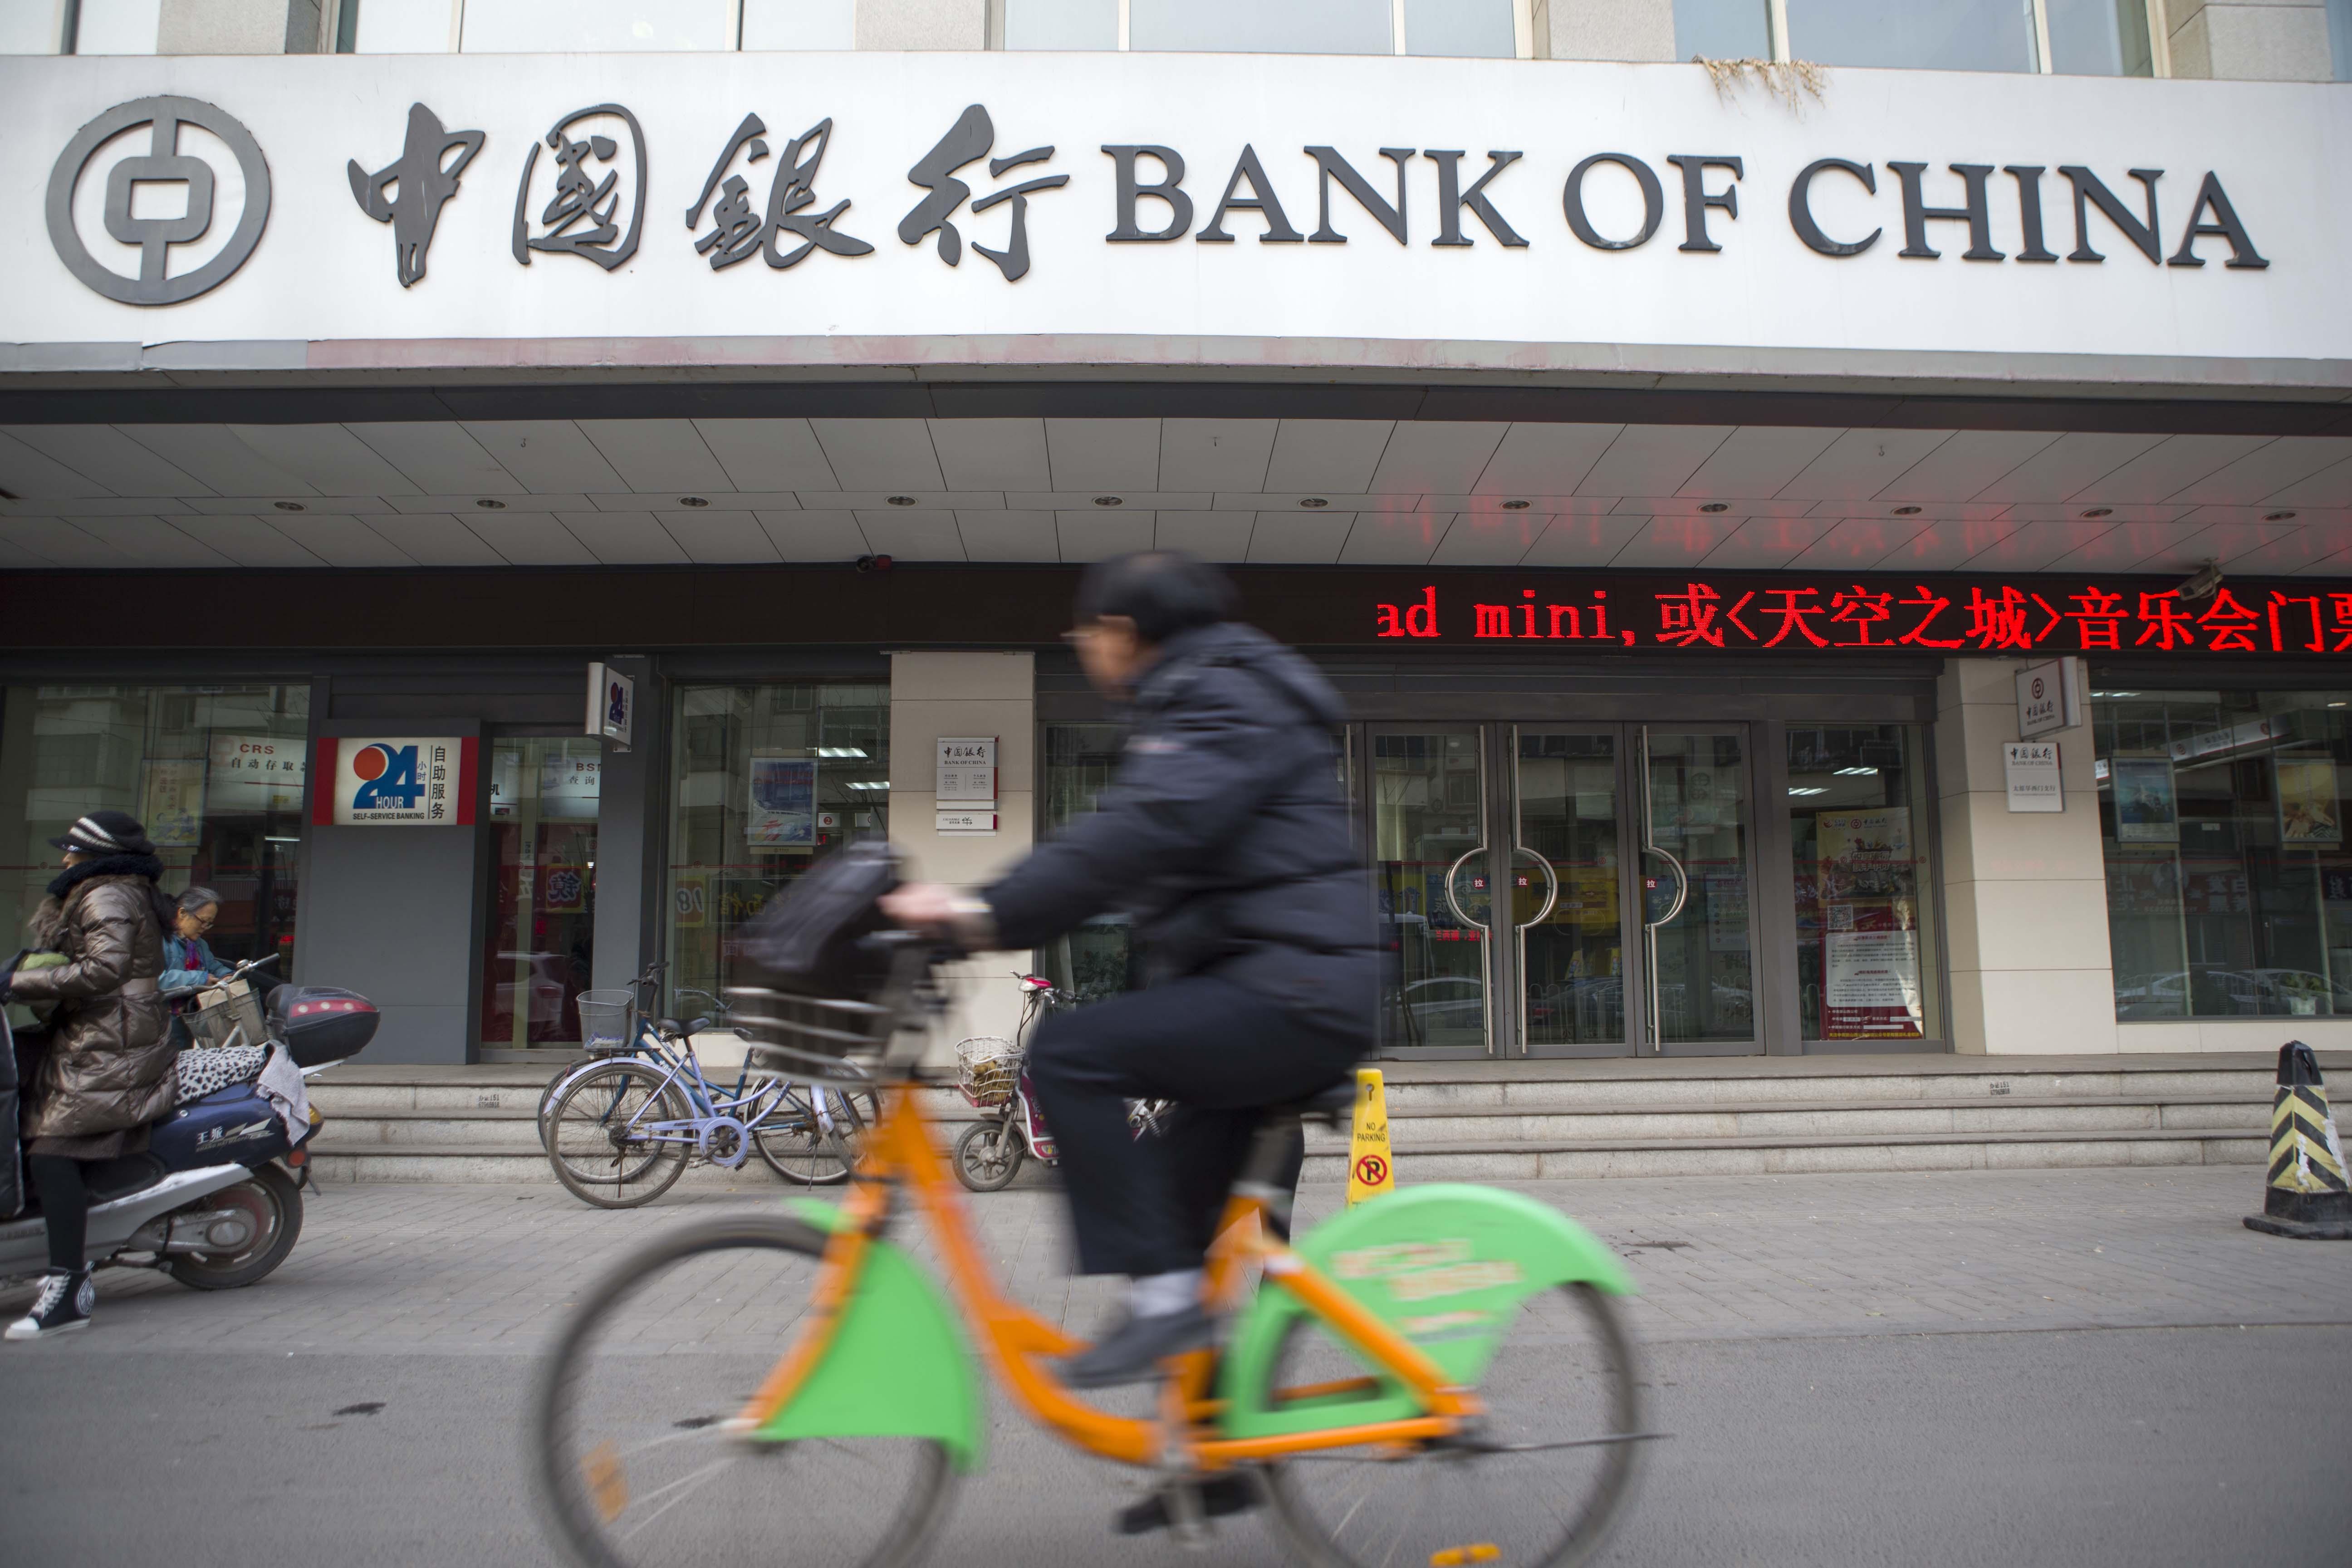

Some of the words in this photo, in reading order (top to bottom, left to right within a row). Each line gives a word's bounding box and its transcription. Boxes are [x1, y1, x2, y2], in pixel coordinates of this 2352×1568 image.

[1101, 144, 1529, 249] BANK
[1563, 153, 1743, 254] OF
[1788, 158, 2270, 271] CHINA
[240, 744, 274, 754] CRS
[353, 743, 425, 809] 24
[417, 761, 426, 781] 小时
[431, 746, 446, 819] 自助服务
[569, 775, 595, 785] 查询
[376, 796, 404, 808] HOUR
[1475, 879, 1484, 887] 拉
[1646, 880, 1656, 888] 拉
[1366, 1122, 1376, 1131] NO
[1357, 1133, 1386, 1142] PARKING
